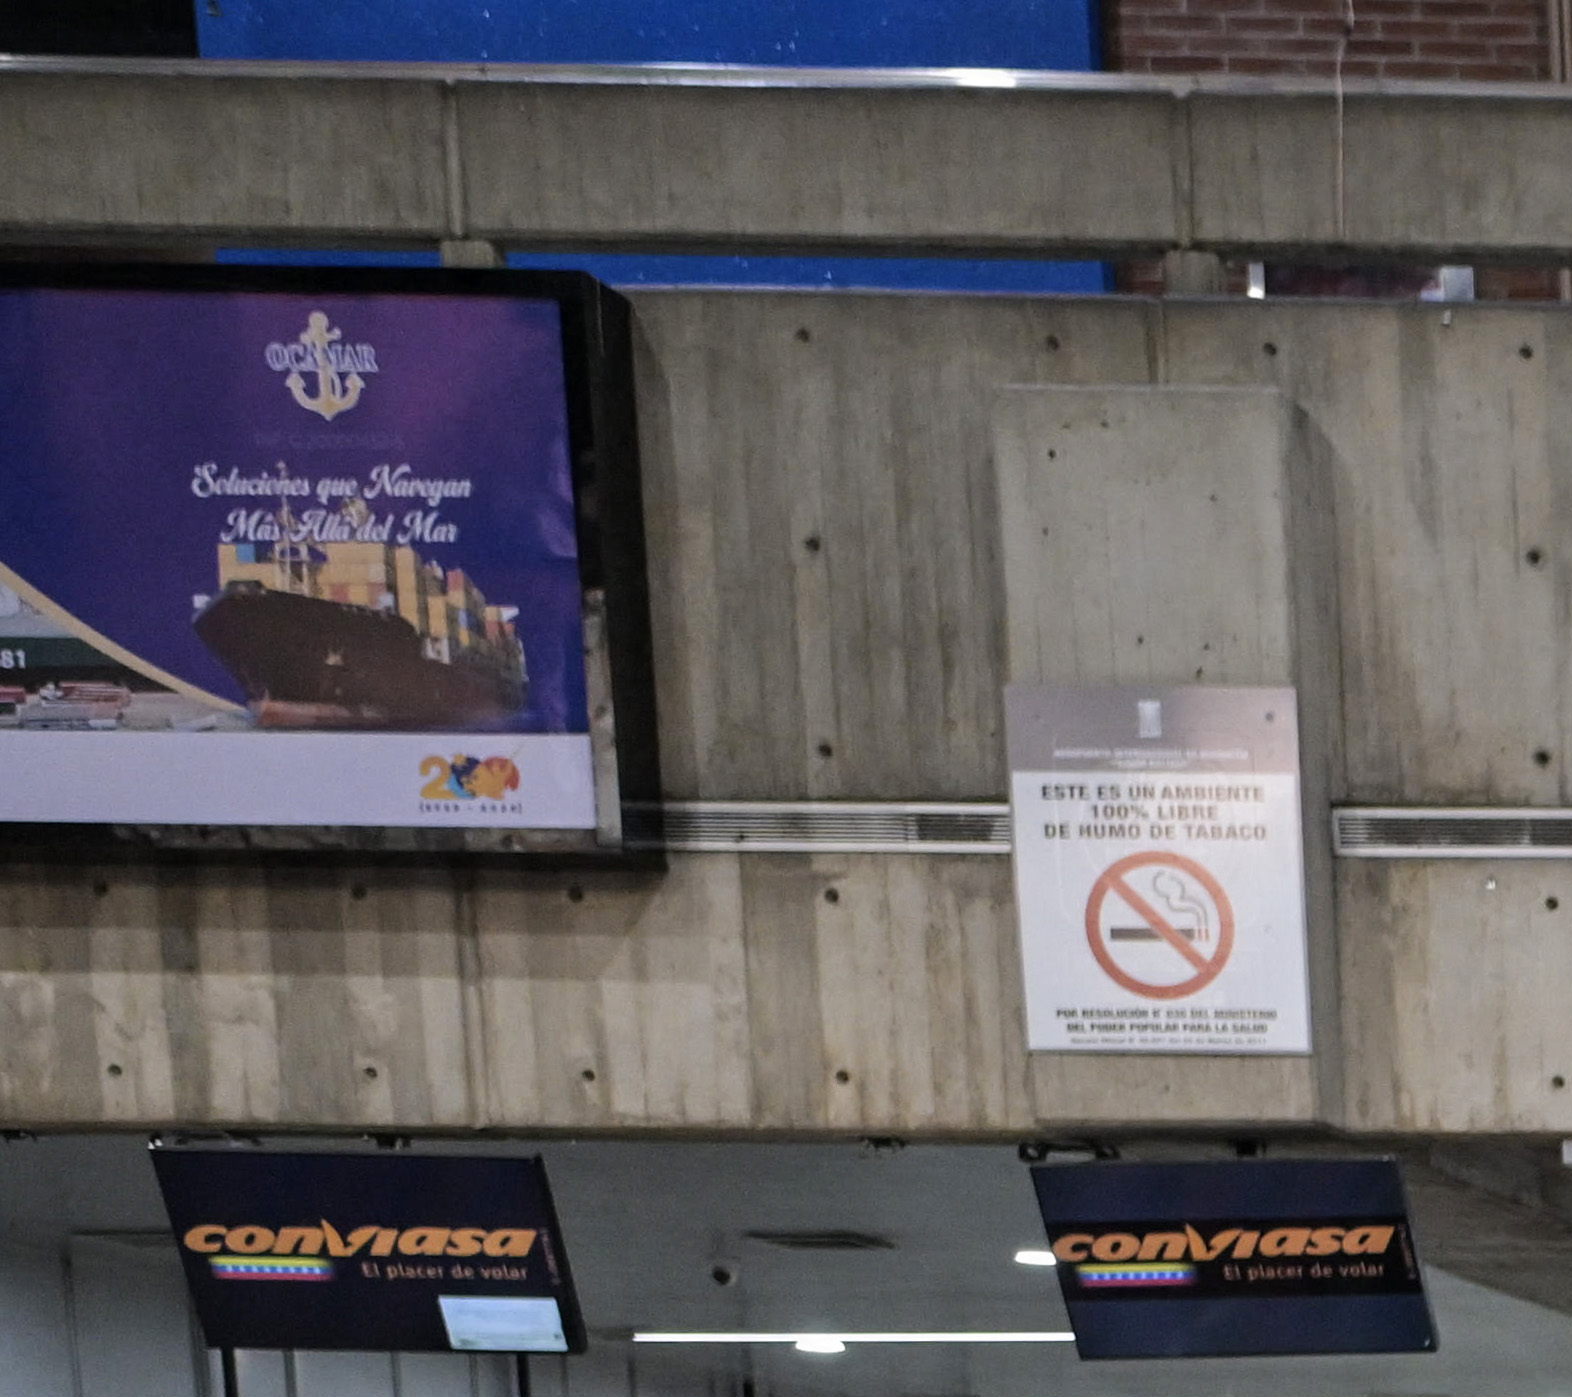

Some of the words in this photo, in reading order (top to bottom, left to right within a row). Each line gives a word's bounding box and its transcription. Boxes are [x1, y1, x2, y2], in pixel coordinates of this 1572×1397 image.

[191, 462, 310, 498] Soluciones
[315, 475, 358, 505] que
[363, 463, 473, 507] Navegan
[355, 512, 395, 543] del
[397, 508, 459, 544] Mar
[1041, 784, 1089, 800] ESTE
[1097, 784, 1121, 800] ES
[1129, 784, 1156, 800] UN
[1160, 785, 1266, 802] AMBIENTE
[1091, 804, 1149, 820] 100%
[1157, 805, 1219, 821] LIBRE
[1044, 823, 1070, 840] DE
[1078, 823, 1142, 840] HUMO
[1149, 824, 1176, 841] DE
[1183, 824, 1268, 841] TABACO
[183, 1218, 537, 1258] conviasa
[1053, 1223, 1396, 1263] conviasa
[362, 1261, 380, 1279] El
[386, 1262, 444, 1281] placer
[451, 1263, 474, 1279] de
[480, 1264, 528, 1281] volar
[1223, 1264, 1242, 1281] El
[1248, 1262, 1303, 1282] placer
[1310, 1261, 1335, 1279] de
[1339, 1261, 1385, 1278] volar
